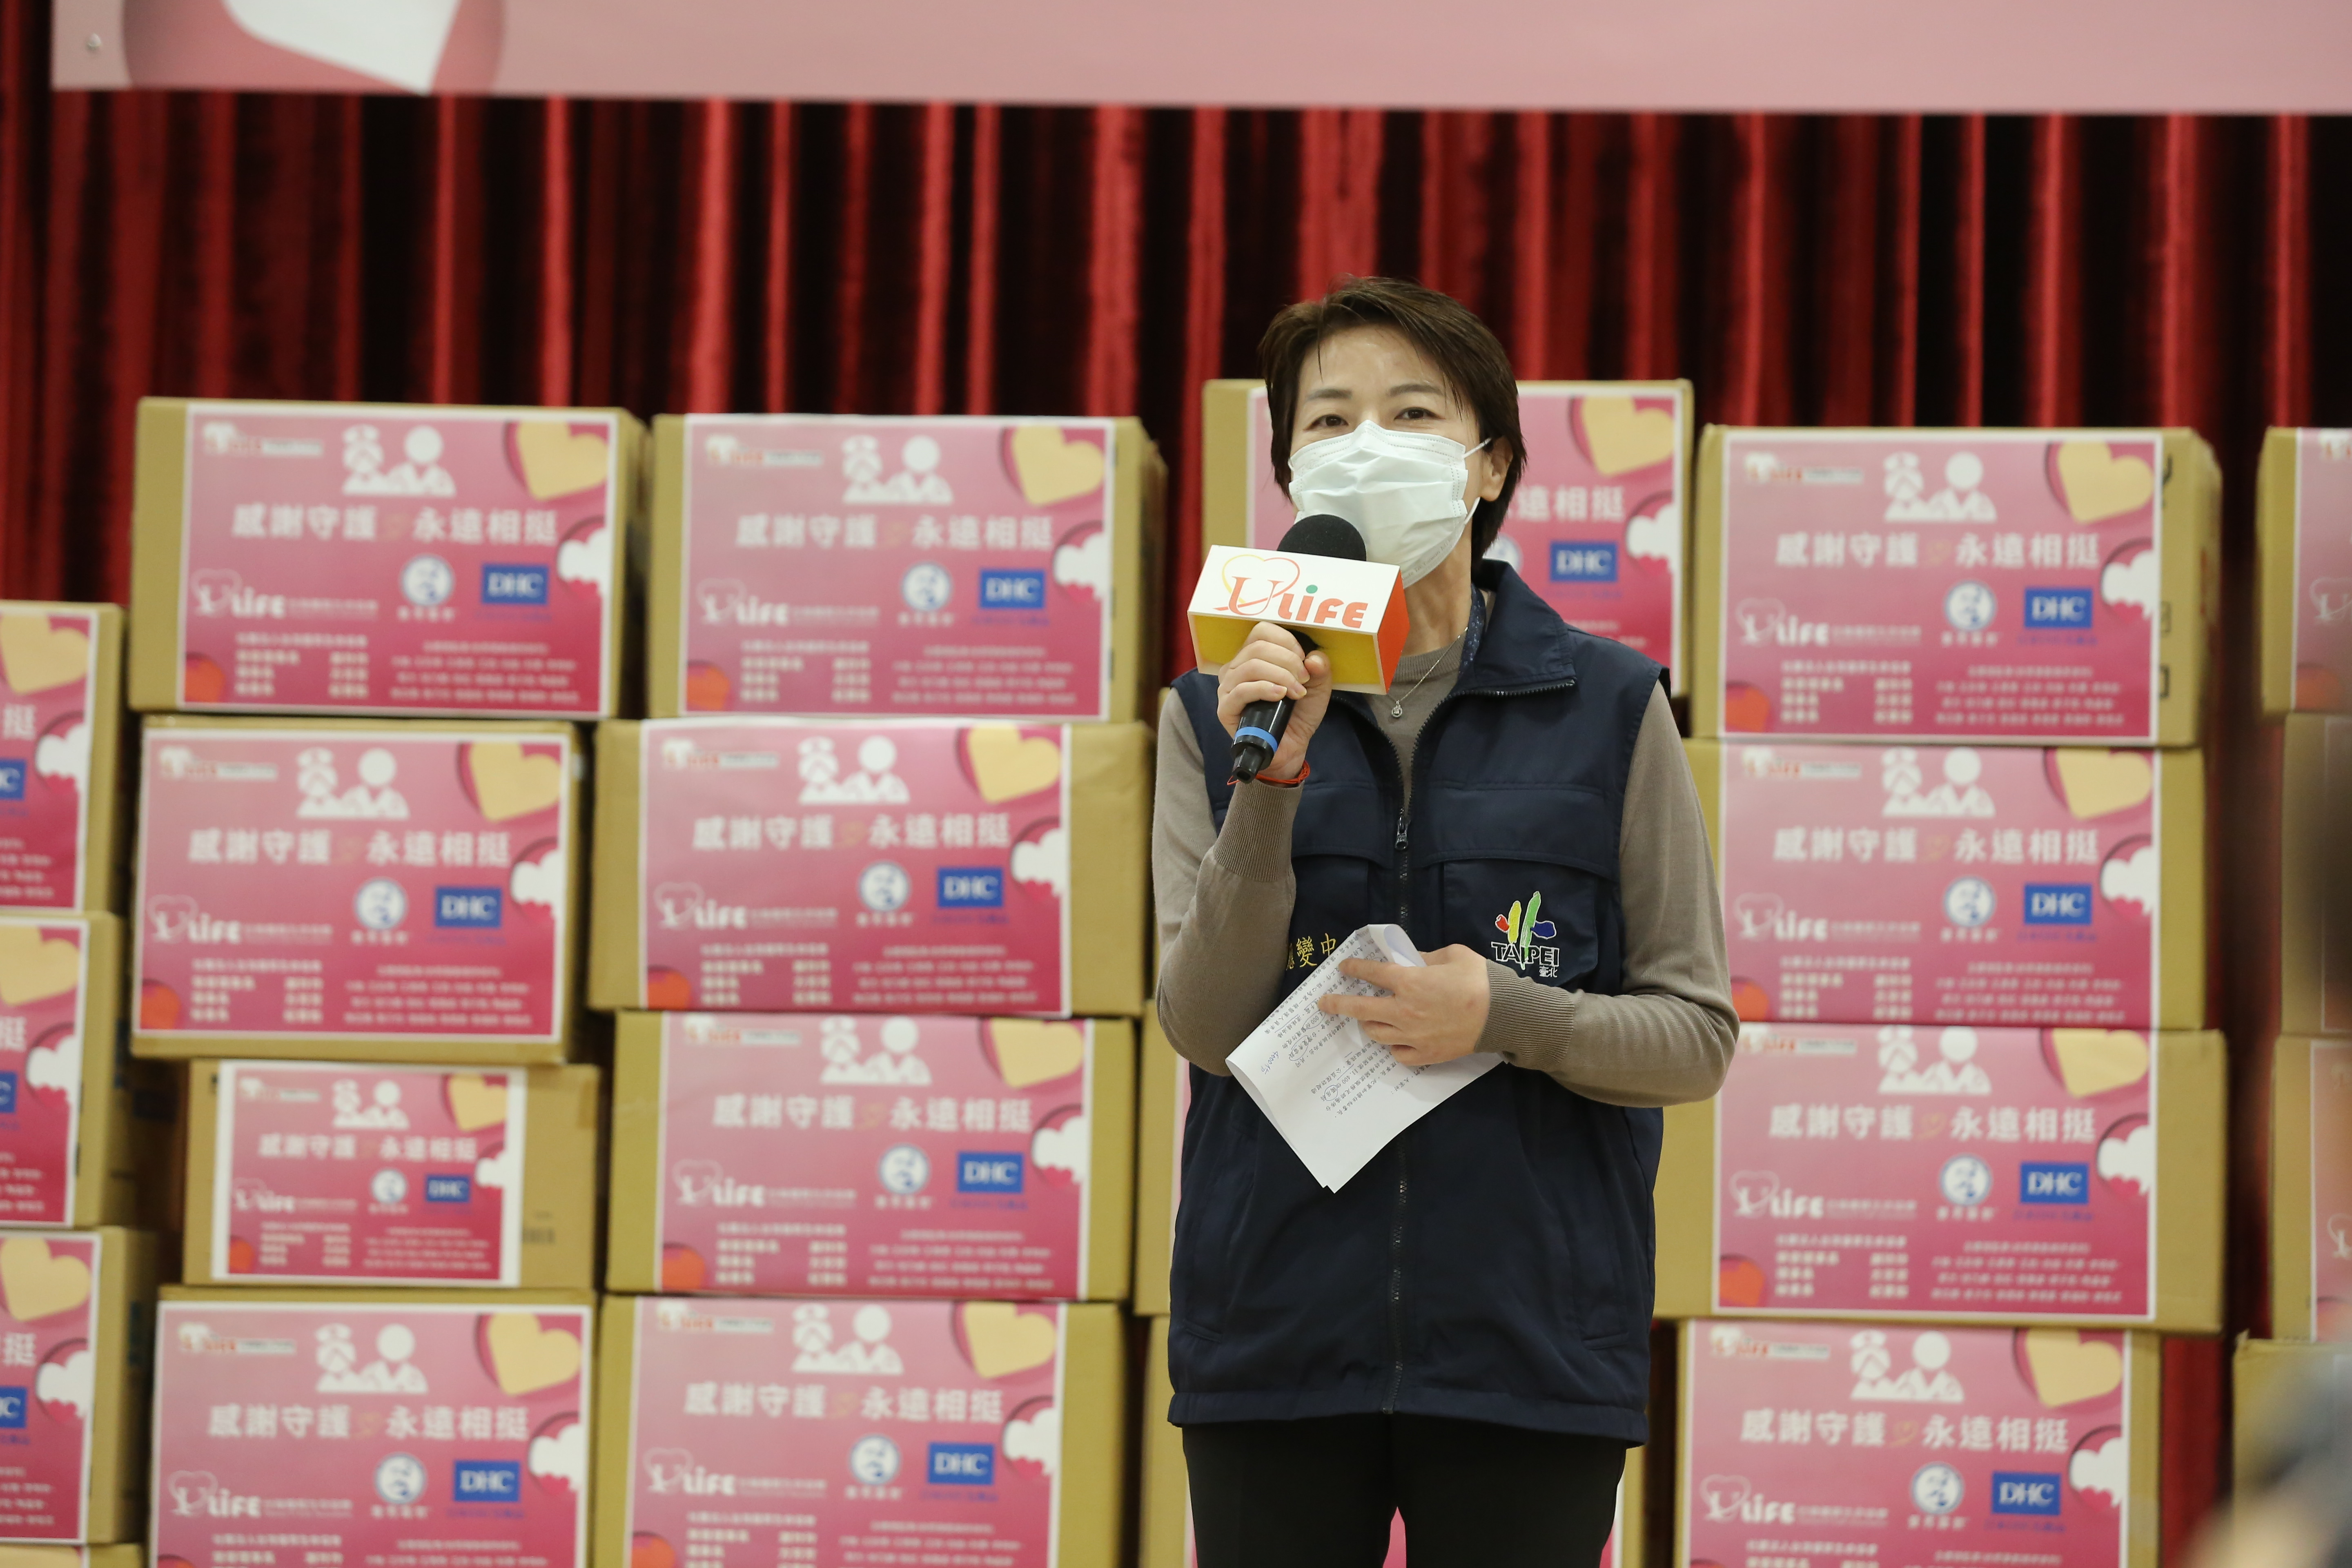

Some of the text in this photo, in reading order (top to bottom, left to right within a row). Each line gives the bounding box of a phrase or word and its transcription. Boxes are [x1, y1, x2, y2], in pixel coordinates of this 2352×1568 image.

[1508, 486, 1624, 522] 遠相挺
[1557, 549, 1611, 571] DHC
[488, 572, 542, 597] DHC
[985, 579, 1039, 601] DHC
[2032, 597, 2085, 621] DHC
[943, 875, 998, 899] DHC
[441, 895, 497, 920] DHC
[2031, 893, 2086, 916] DHC
[1491, 941, 1559, 967] TAIPEI
[1539, 966, 1558, 977] 臺北
[964, 1160, 1017, 1184] DHC
[2027, 1172, 2082, 1195] DHC
[934, 1452, 988, 1476] DHC
[460, 1470, 514, 1492] DHC
[1999, 1481, 2053, 1507] DHC
